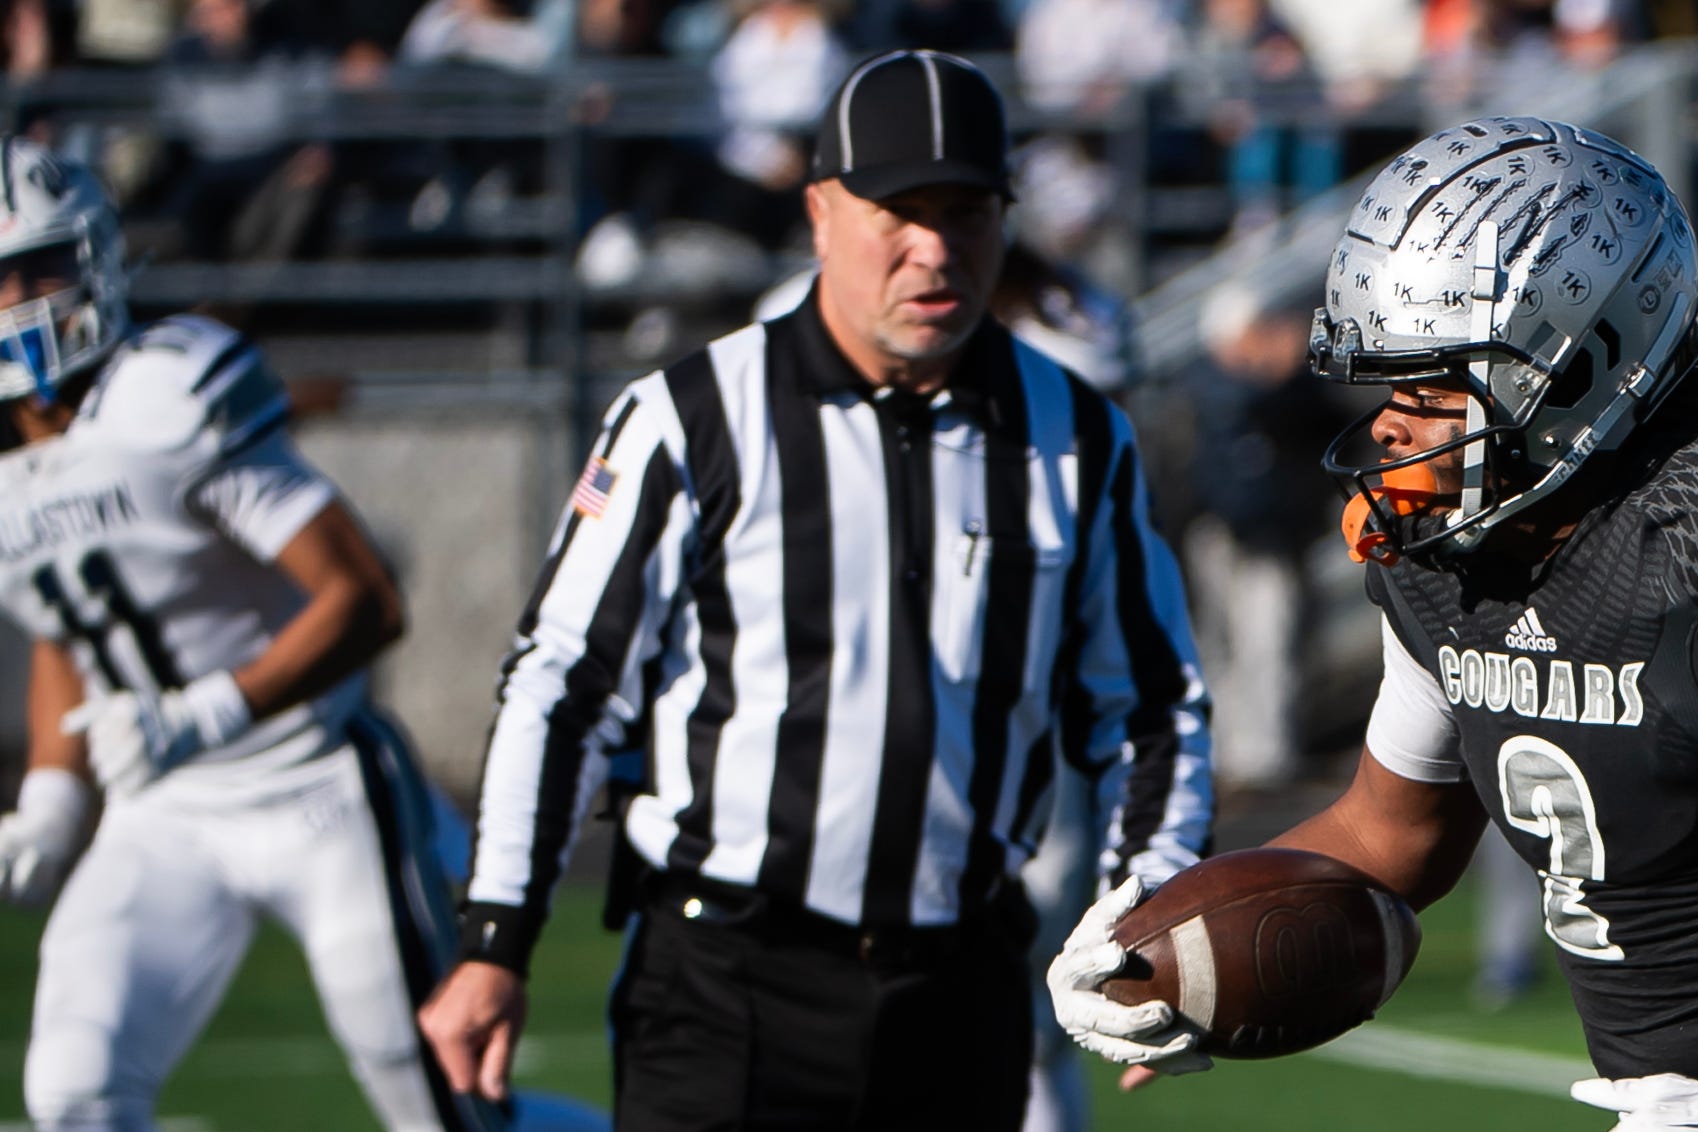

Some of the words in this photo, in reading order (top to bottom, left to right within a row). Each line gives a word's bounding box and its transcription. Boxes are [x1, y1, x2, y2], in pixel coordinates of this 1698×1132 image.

[1447, 141, 1470, 156] 1K
[1543, 146, 1567, 165] 1K
[1508, 156, 1526, 175] 1K
[1592, 160, 1615, 181] 1K
[1402, 170, 1421, 186] 1K
[1463, 175, 1486, 193] 1K
[1374, 205, 1392, 222] 1K
[1431, 202, 1454, 223] 1K
[1615, 198, 1637, 221] 1K
[1592, 235, 1615, 259] 1K
[1354, 272, 1371, 291] 1K
[1561, 271, 1586, 298] 1K
[1394, 282, 1413, 303] 1K
[1441, 290, 1466, 308] 1K
[1512, 286, 1537, 307] 1K
[1368, 310, 1388, 332] 1K
[1413, 318, 1436, 335] 1K
[33, 548, 184, 692] 11
[1505, 632, 1558, 652] adidas
[1438, 645, 1646, 727] COUGARS
